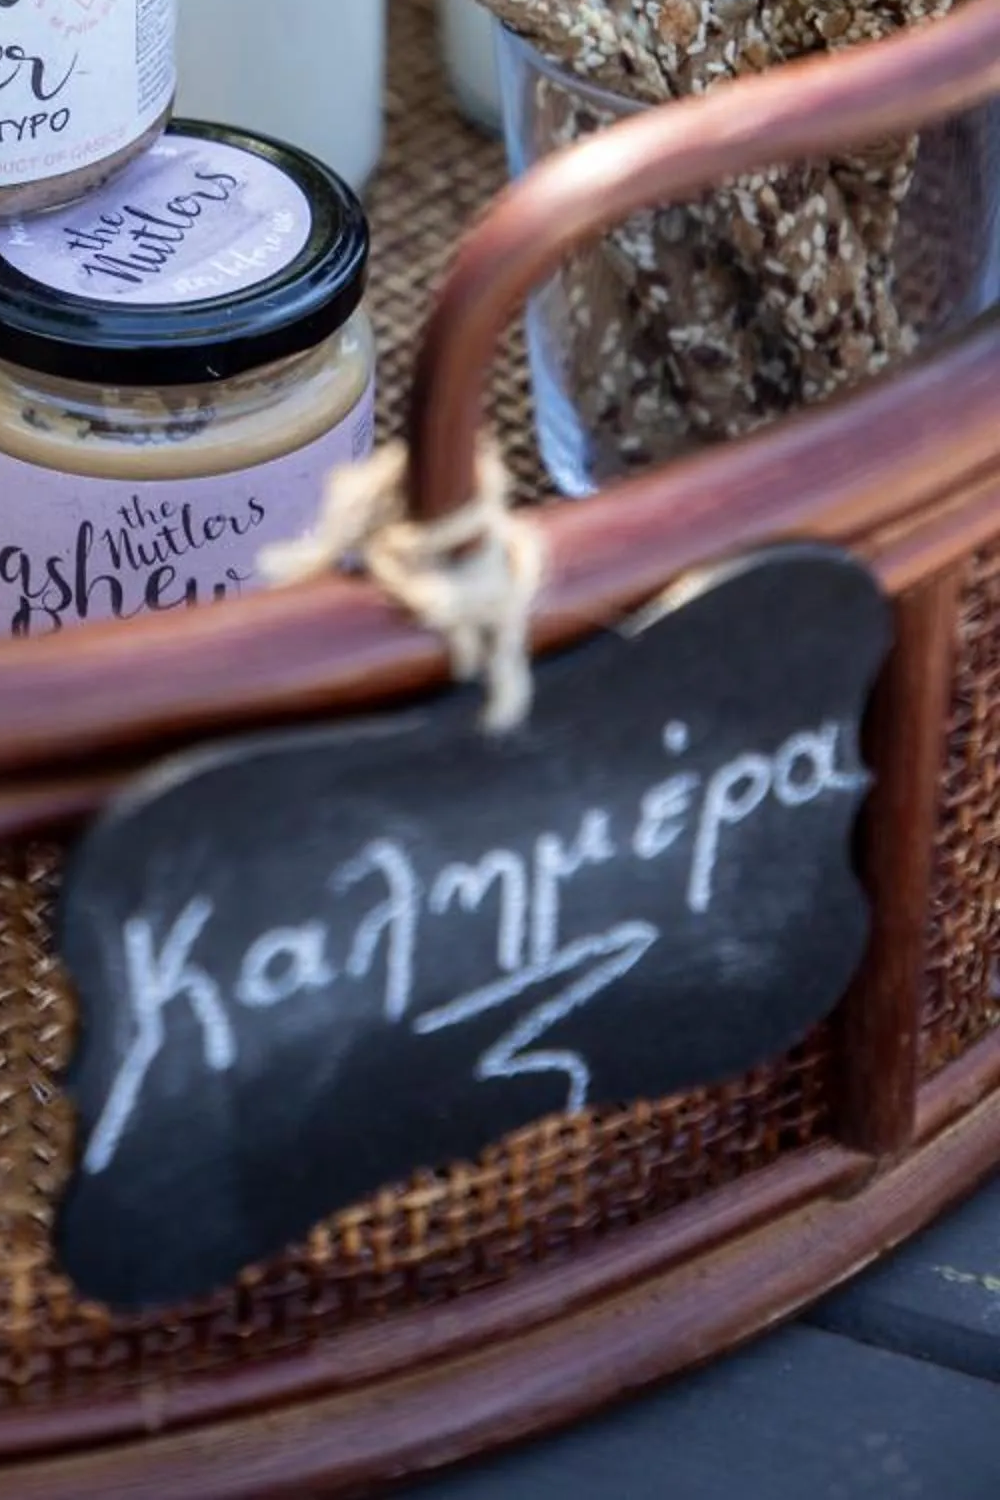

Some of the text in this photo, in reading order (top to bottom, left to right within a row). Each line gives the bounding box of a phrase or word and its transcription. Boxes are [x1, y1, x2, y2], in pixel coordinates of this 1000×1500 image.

[63, 212, 125, 251] the
[81, 171, 238, 284] Nutlers
[101, 497, 265, 570] Nutlers
[117, 494, 176, 530] the
